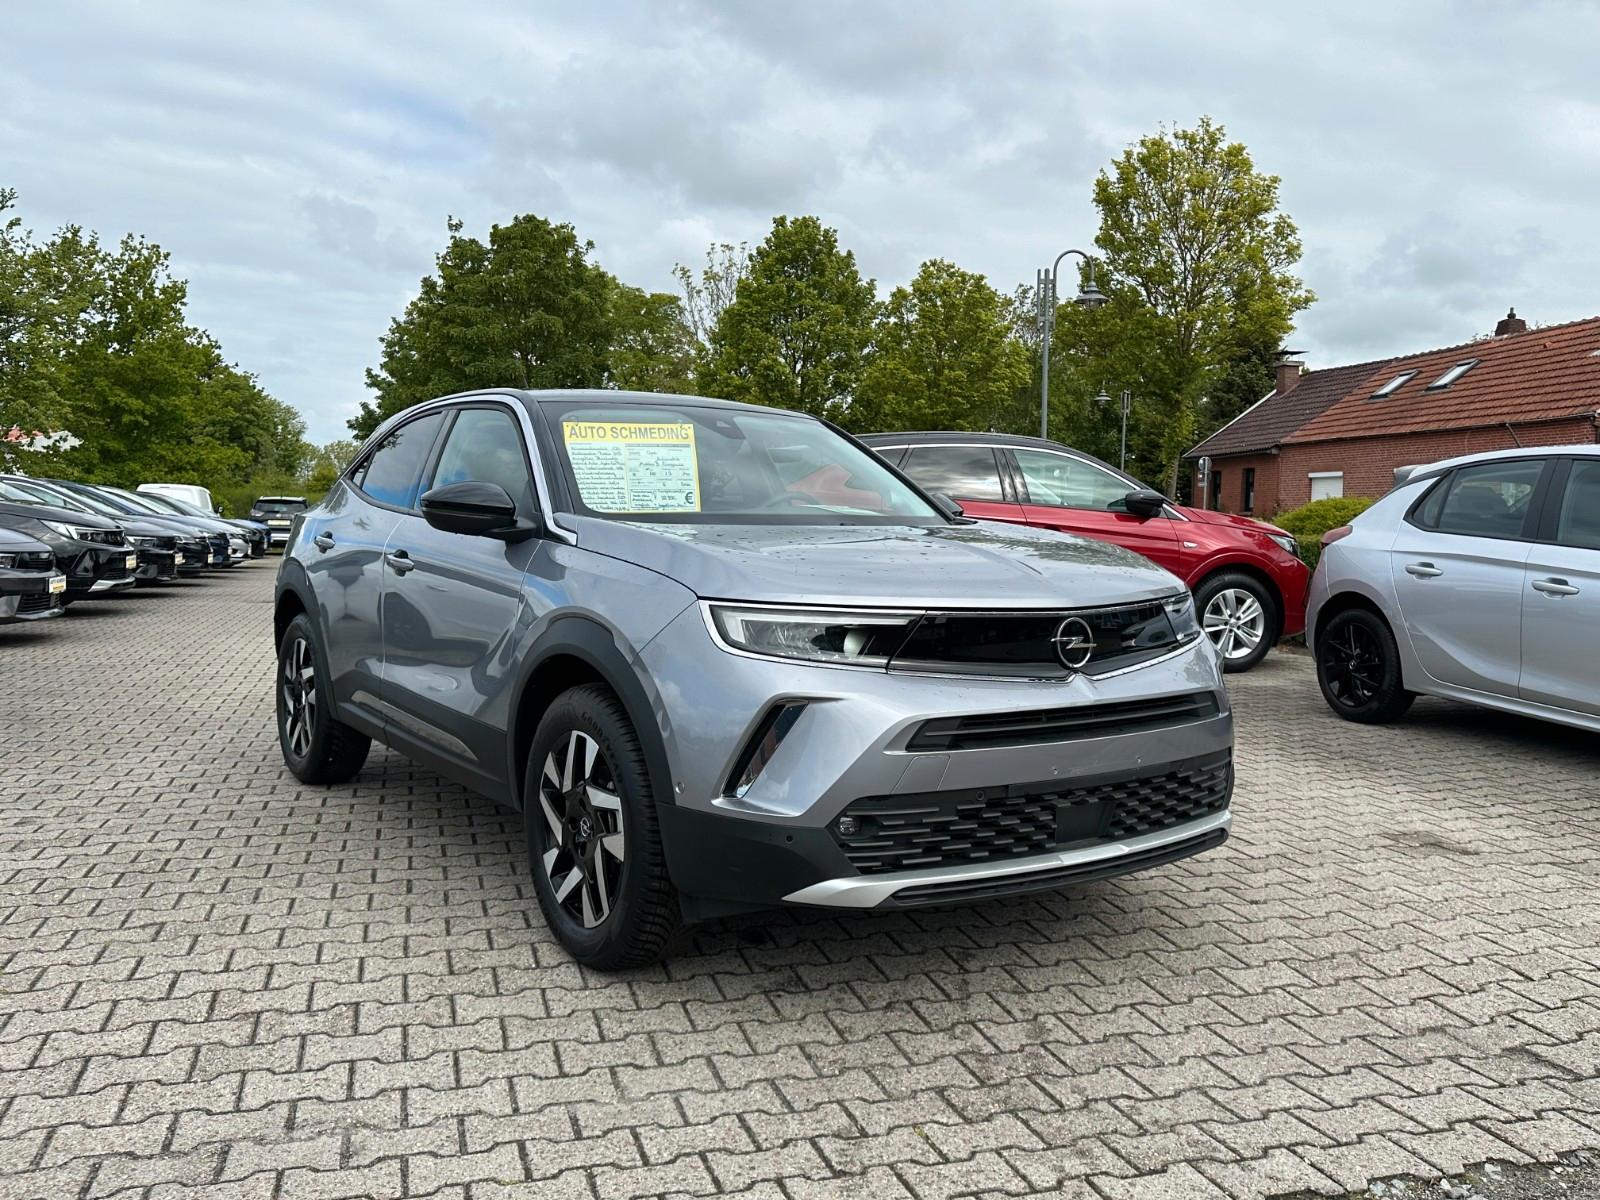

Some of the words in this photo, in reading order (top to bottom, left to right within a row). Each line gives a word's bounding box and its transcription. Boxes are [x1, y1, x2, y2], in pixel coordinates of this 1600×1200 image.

[569, 425, 606, 439] AUTO
[610, 426, 690, 440] SCHMEDING
[684, 491, 694, 505] €
